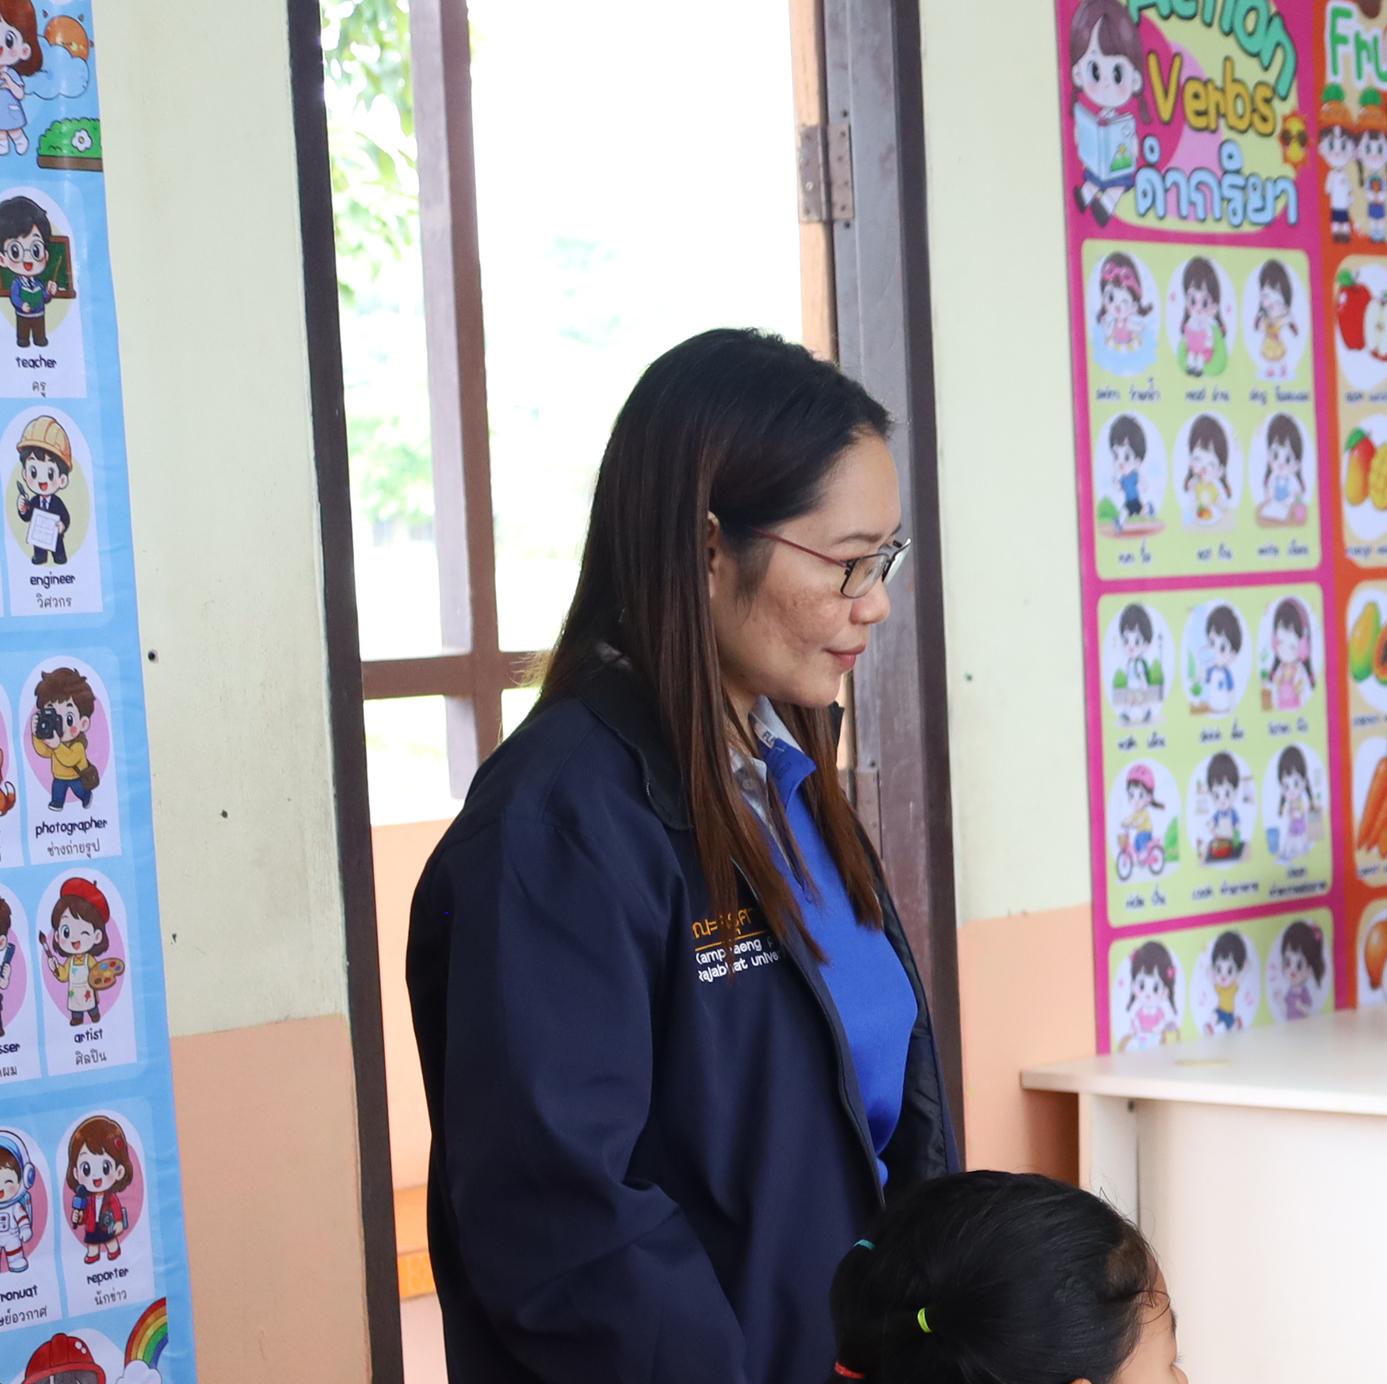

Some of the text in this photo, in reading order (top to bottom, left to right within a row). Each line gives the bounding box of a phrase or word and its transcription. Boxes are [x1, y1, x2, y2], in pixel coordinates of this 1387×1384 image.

[1148, 51, 1276, 136] Verbs
[16, 354, 57, 368] teacher
[32, 381, 47, 398] ครู
[30, 571, 76, 589] engineer
[36, 593, 72, 608] วิศวกร
[35, 816, 107, 838] photographer
[47, 838, 100, 859] ช่างถ่ายรูป
[74, 1028, 103, 1043] artist
[0, 1043, 21, 1055] sser
[75, 1048, 107, 1065] ศิลปิน
[87, 1267, 129, 1286] reporter
[94, 1288, 128, 1305] นักข่าว
